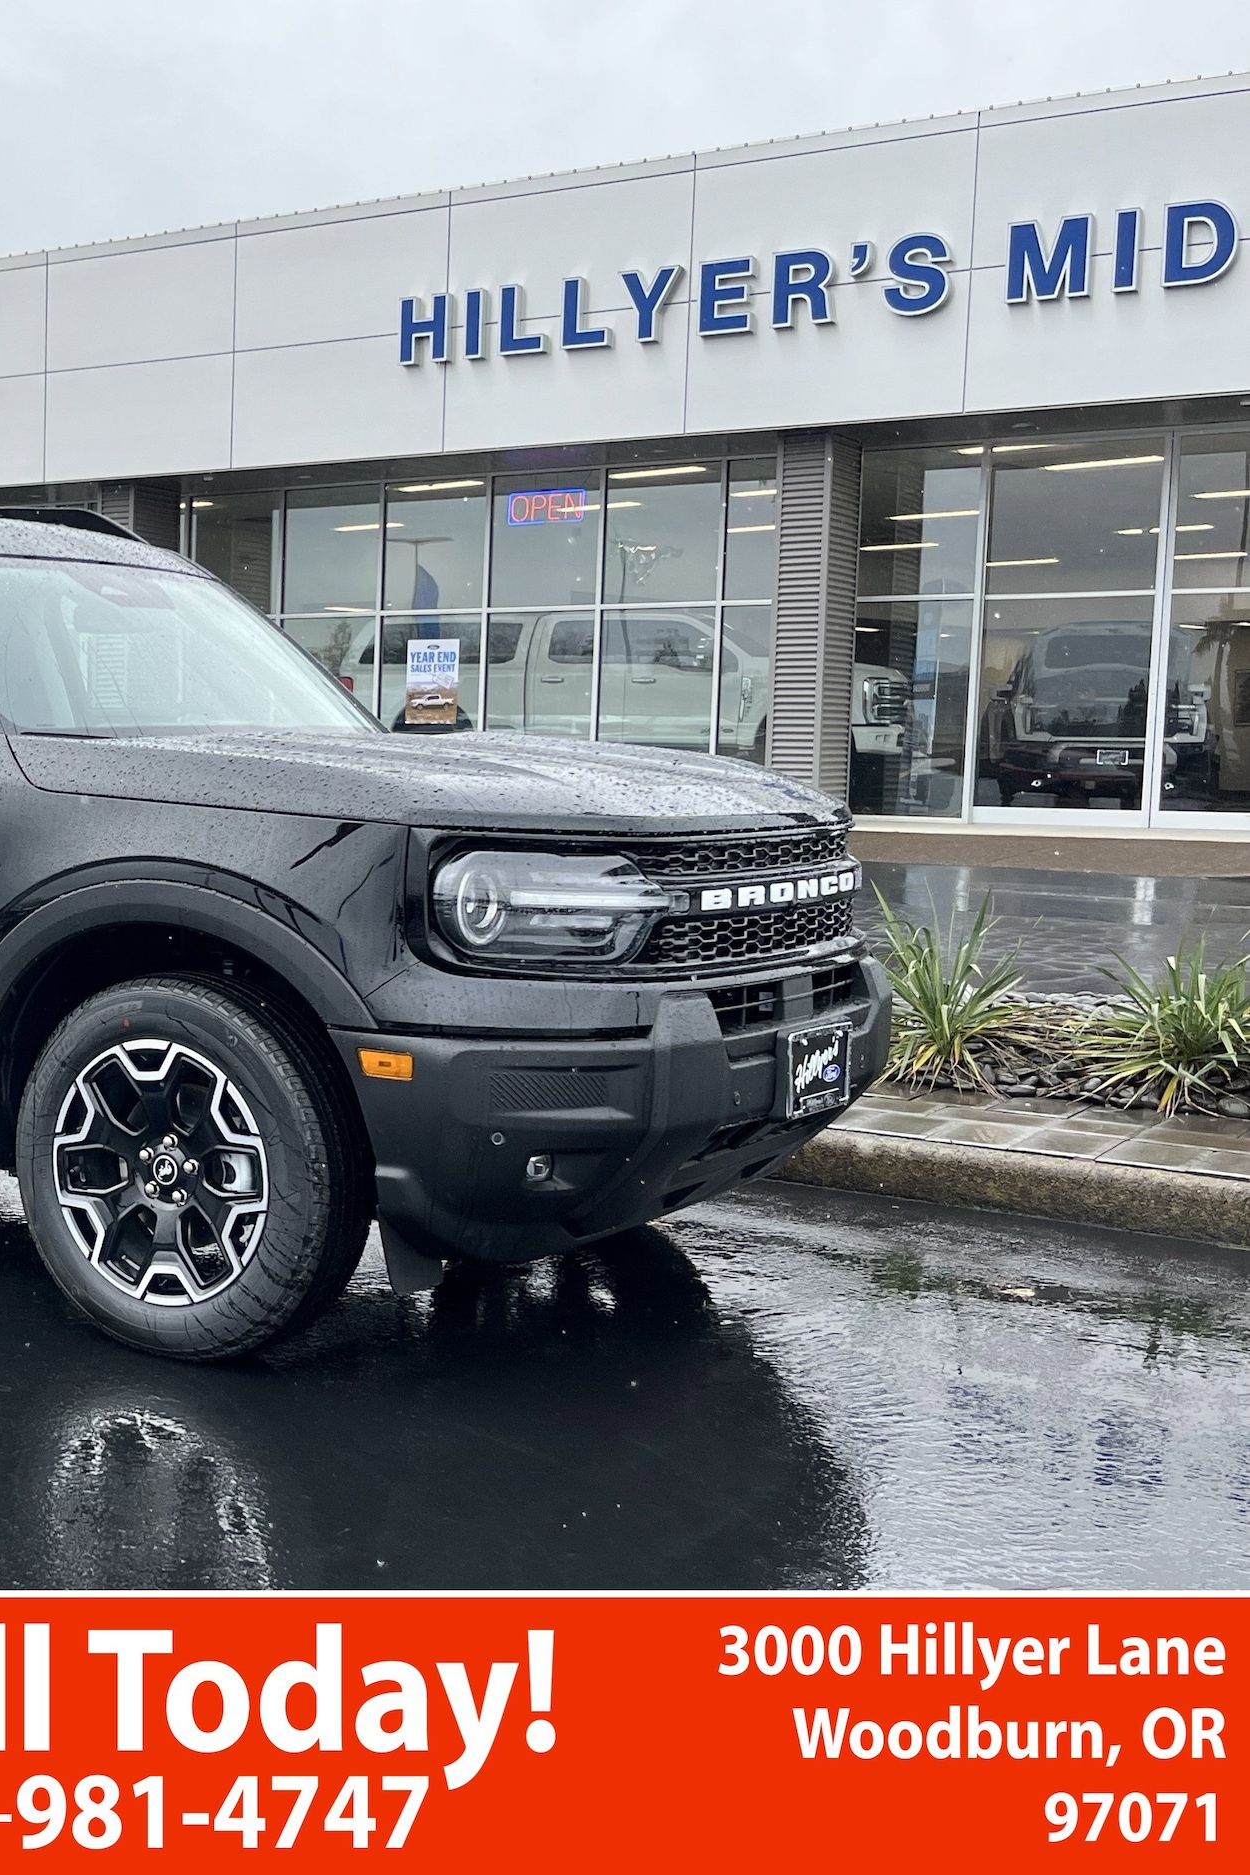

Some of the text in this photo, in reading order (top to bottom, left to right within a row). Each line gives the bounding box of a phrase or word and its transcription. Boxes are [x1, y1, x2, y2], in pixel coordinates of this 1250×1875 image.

[397, 199, 1239, 365] HILLYER'S MID
[511, 492, 583, 522] OPEN
[410, 651, 457, 664] YEAR END
[410, 663, 455, 673] SALES EVENT
[700, 872, 854, 911] BRONCO
